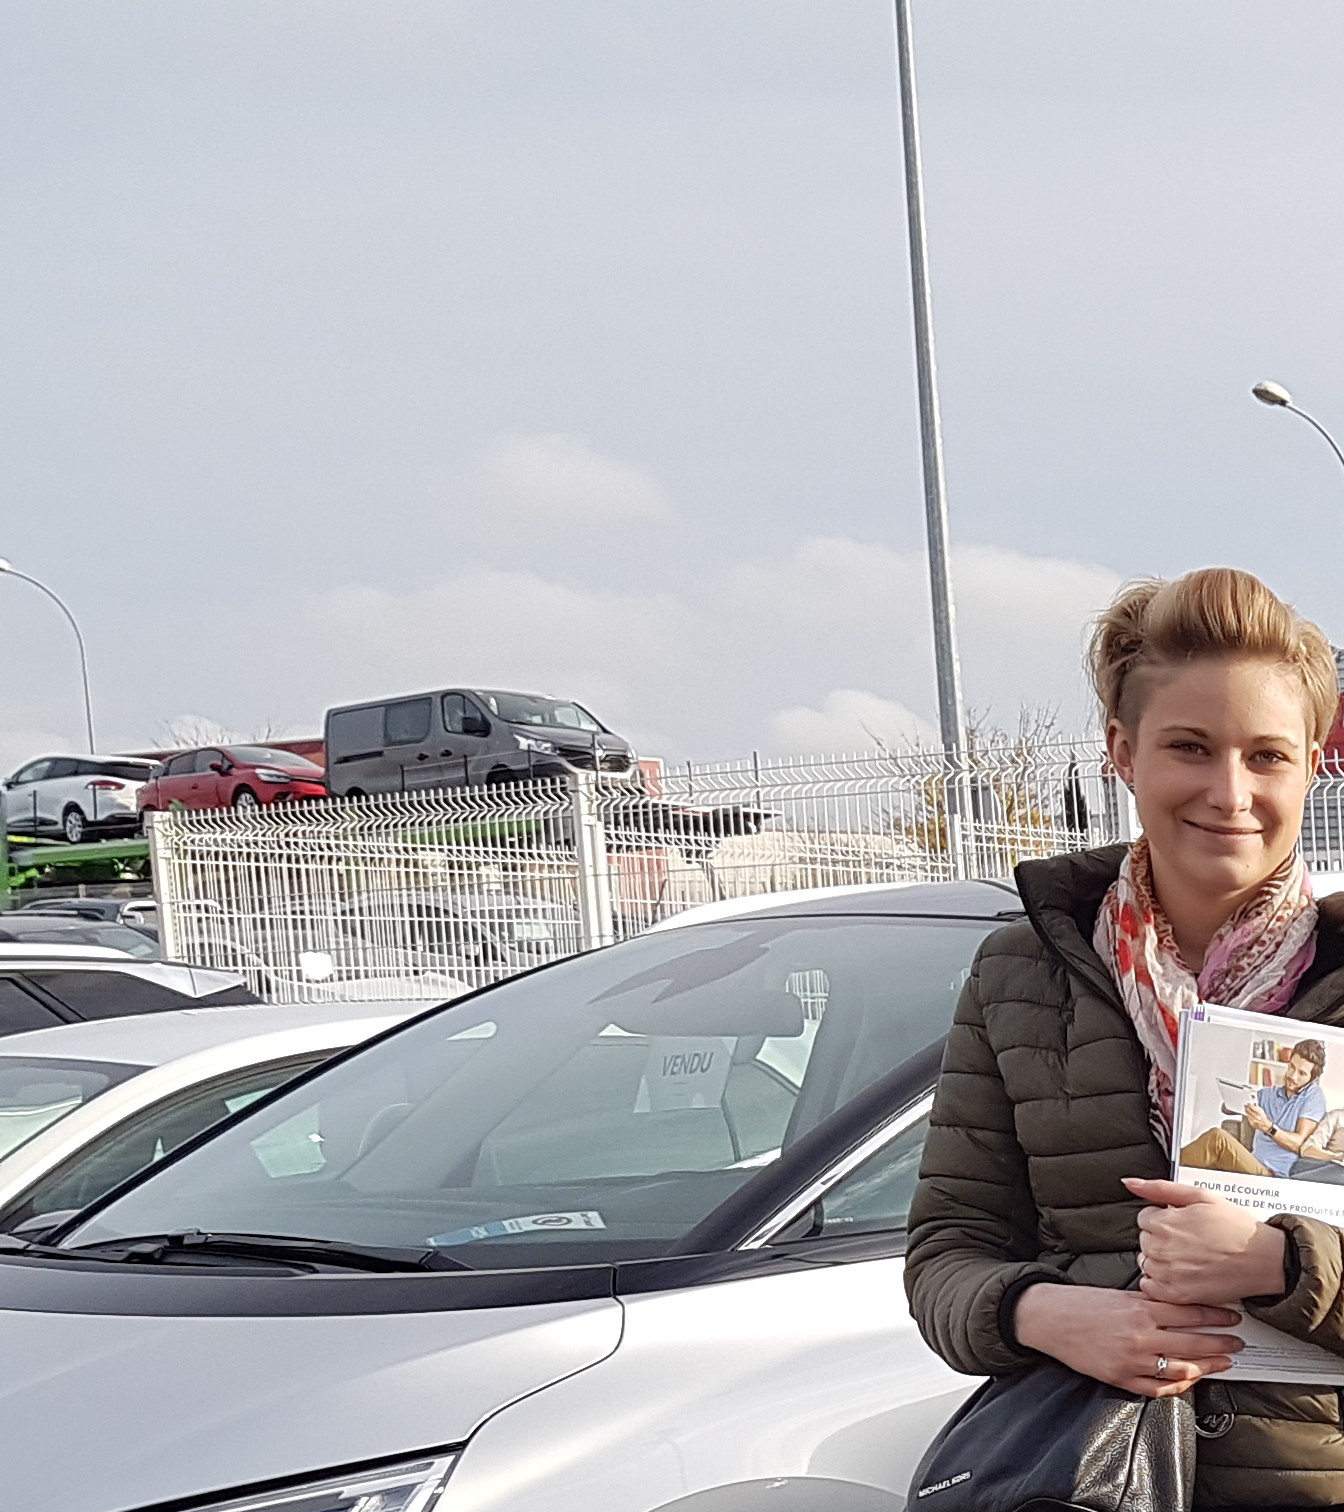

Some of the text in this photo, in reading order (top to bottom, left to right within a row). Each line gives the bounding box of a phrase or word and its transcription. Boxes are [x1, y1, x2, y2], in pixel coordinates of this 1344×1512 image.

[662, 1051, 714, 1077] VENDU
[1194, 1181, 1280, 1198] POUR DÉCOUVRIR
[1252, 1200, 1265, 1209] DE
[1268, 1202, 1287, 1211] NOS
[1289, 1204, 1334, 1216] PRODUITS
